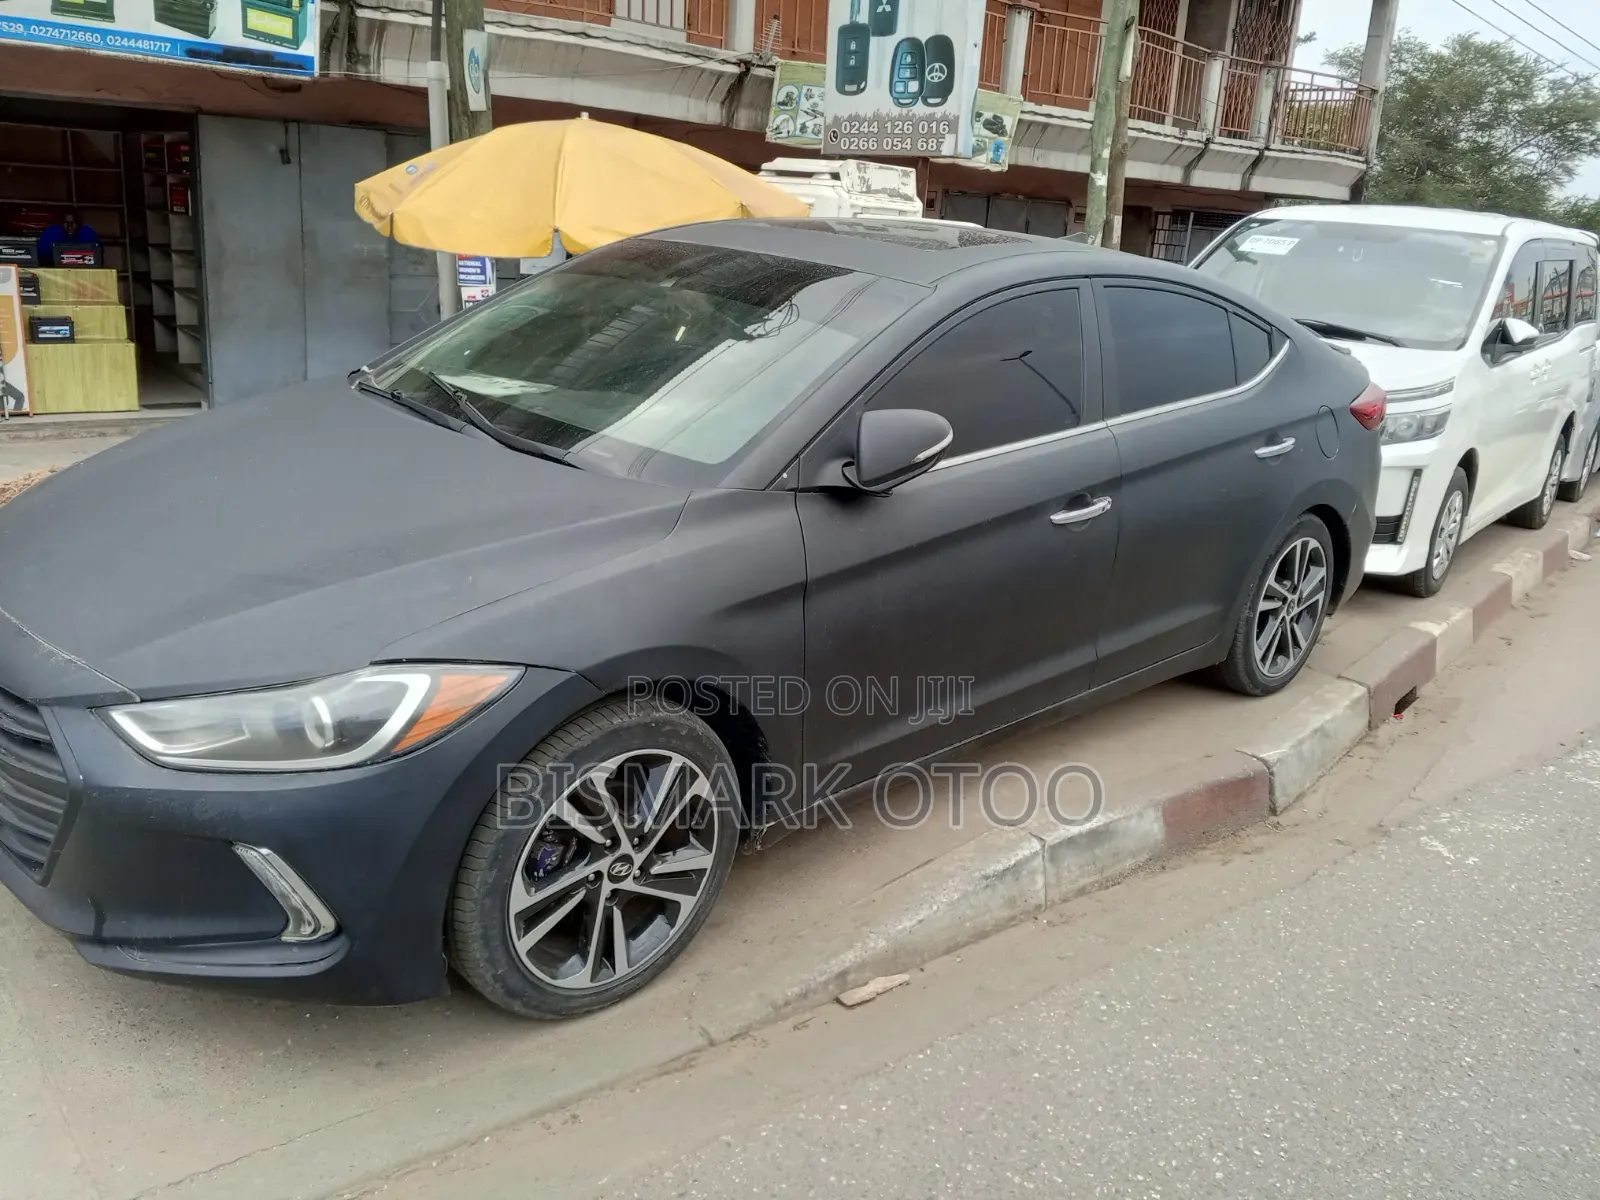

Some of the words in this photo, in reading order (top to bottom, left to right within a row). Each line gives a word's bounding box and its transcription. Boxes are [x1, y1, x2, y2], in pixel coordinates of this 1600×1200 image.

[30, 25, 104, 46] 0274712660,
[107, 36, 171, 53] 0244481717
[841, 120, 879, 134] 0244
[884, 120, 913, 134] 126
[918, 121, 949, 135] 016
[840, 137, 878, 150] 0266
[883, 137, 912, 151] 054
